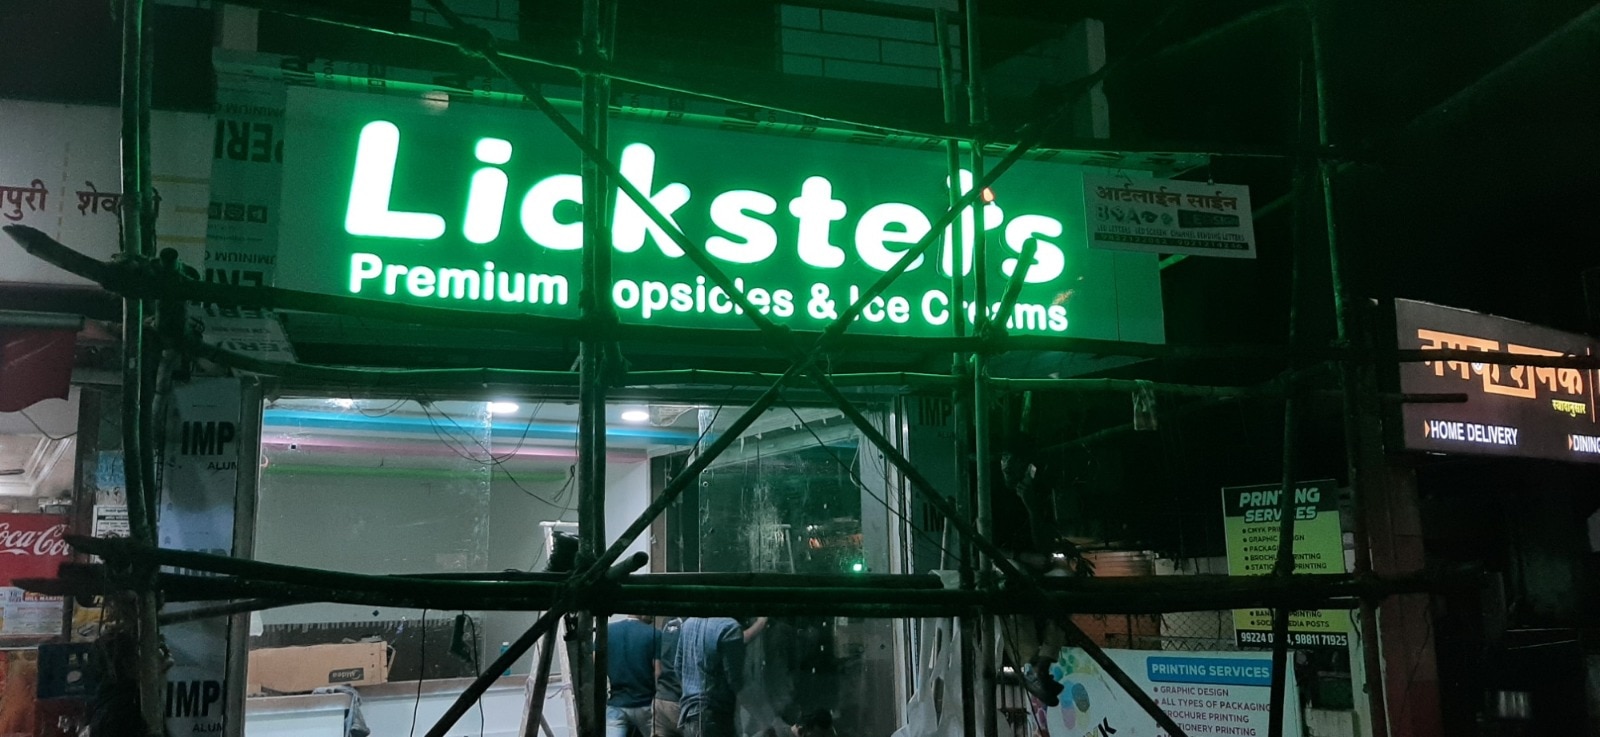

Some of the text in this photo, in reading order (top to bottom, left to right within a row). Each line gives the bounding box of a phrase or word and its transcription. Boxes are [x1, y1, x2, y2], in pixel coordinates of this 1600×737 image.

[0, 178, 48, 220] पुरी
[345, 120, 1064, 284] Licksters
[349, 252, 1069, 332] Premium opsicles & Ice Cms
[181, 421, 236, 455] IMP
[1430, 420, 1518, 446] HOME DELIVERY
[1239, 487, 1321, 508] PRINNG
[1244, 505, 1317, 522] SERVES
[1247, 526, 1265, 534] CMYK
[0, 522, 70, 556] oca-Co
[1295, 562, 1328, 570] PRINTING
[1241, 632, 1266, 644] 99224
[1295, 634, 1320, 646] 98811
[1322, 634, 1348, 646] 71925
[1152, 663, 1270, 678] PRINTING SERVICES
[1160, 686, 1229, 697] GRAPHIC DESIGN
[1161, 698, 1176, 706] ALL
[1178, 699, 1204, 708] TYPES
[1219, 702, 1271, 712] PACKAGING
[1209, 713, 1250, 723] PRINTING
[1179, 723, 1256, 736] TIONERY PRINTING
